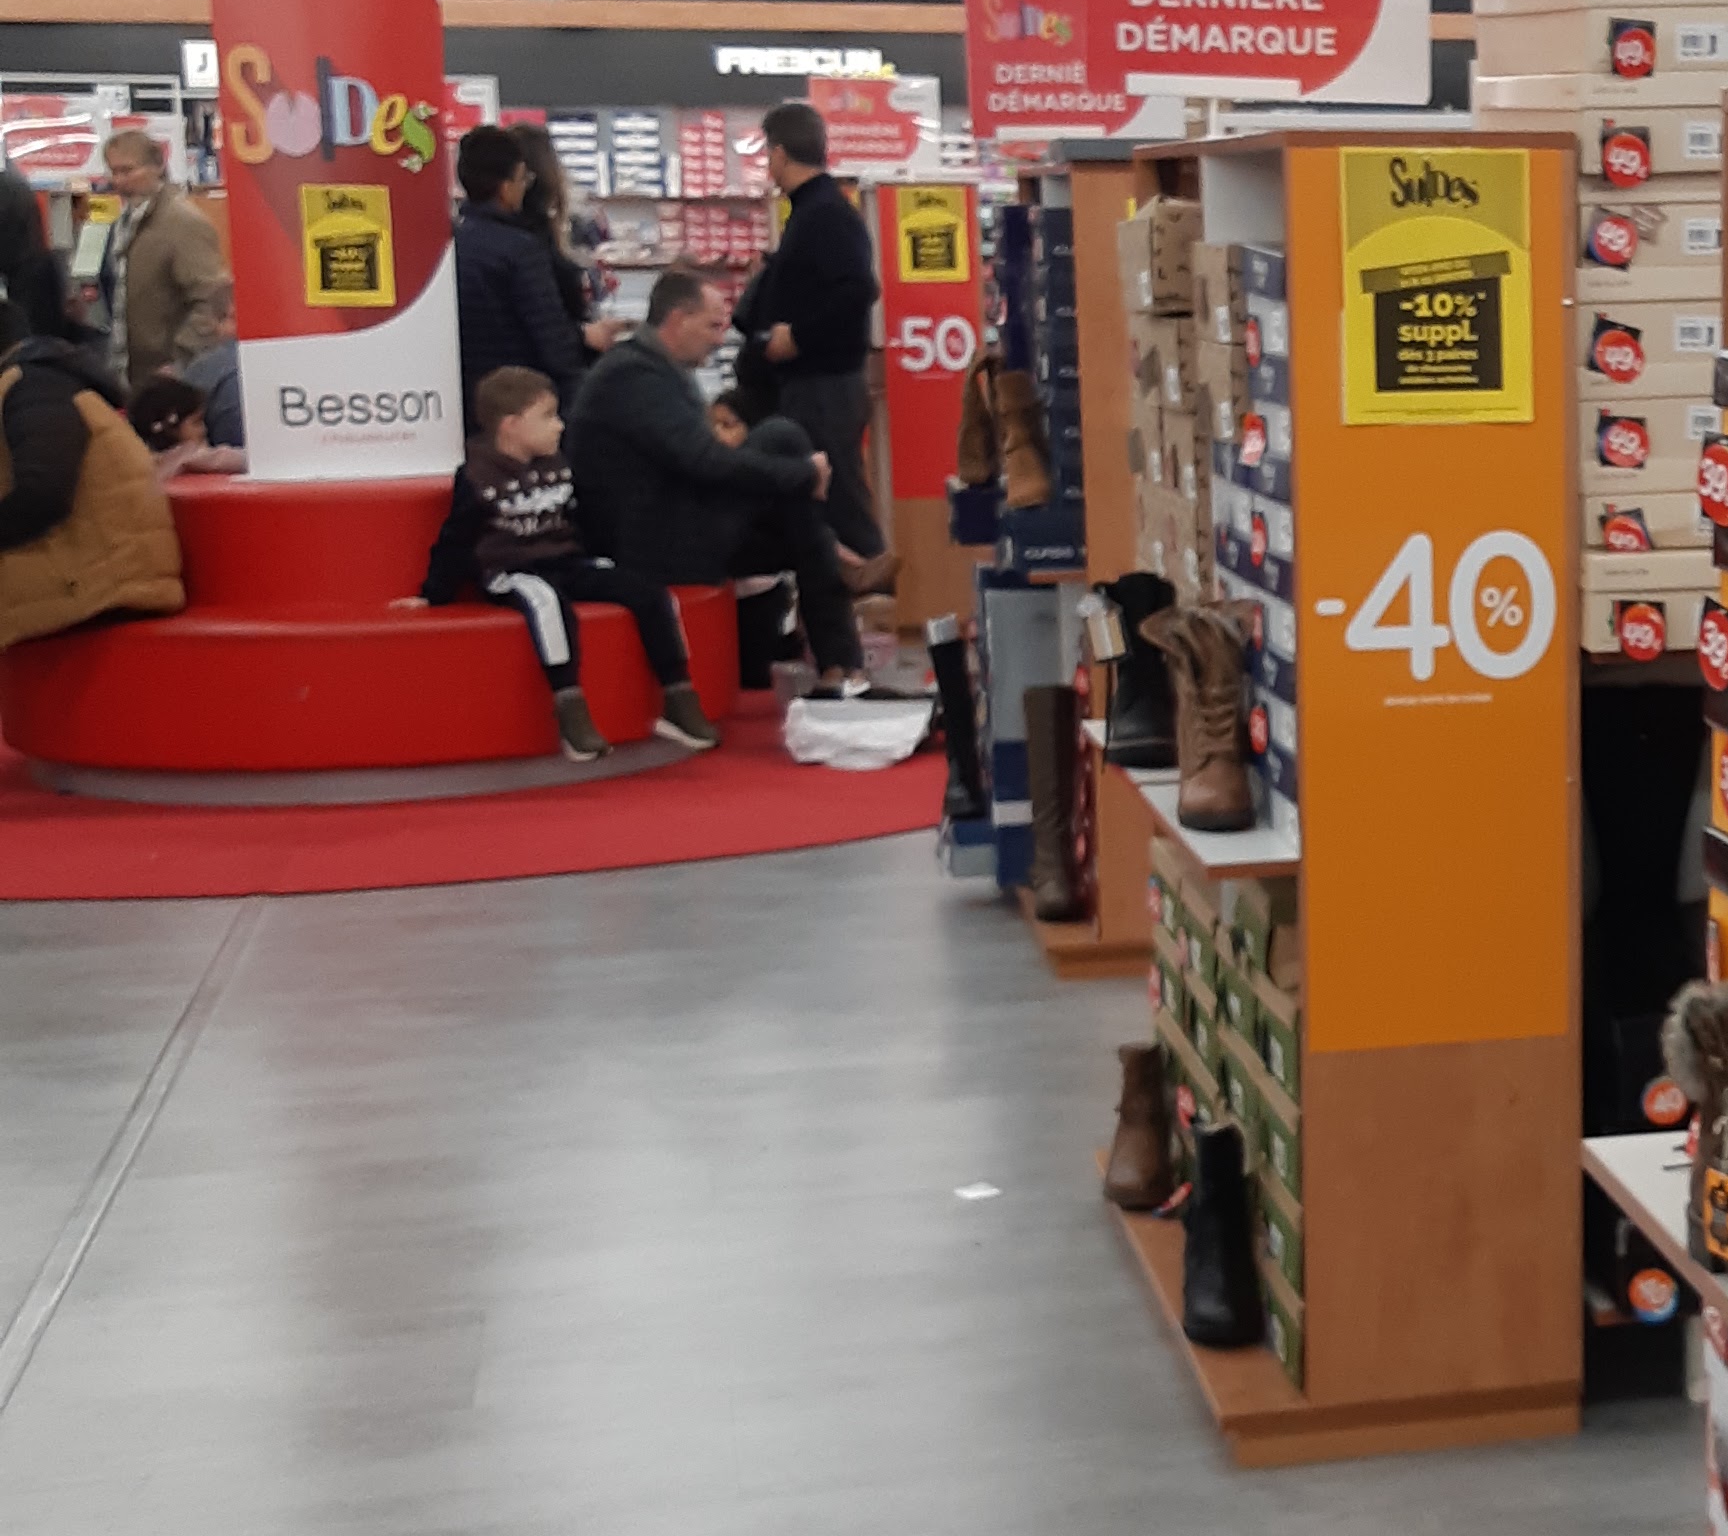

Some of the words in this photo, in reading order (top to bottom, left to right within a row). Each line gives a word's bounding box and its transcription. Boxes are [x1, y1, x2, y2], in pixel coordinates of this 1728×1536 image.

[1116, 15, 1339, 56] DÉMARQUE
[996, 60, 1086, 86] DERNIÈ
[279, 385, 444, 427] Besson
